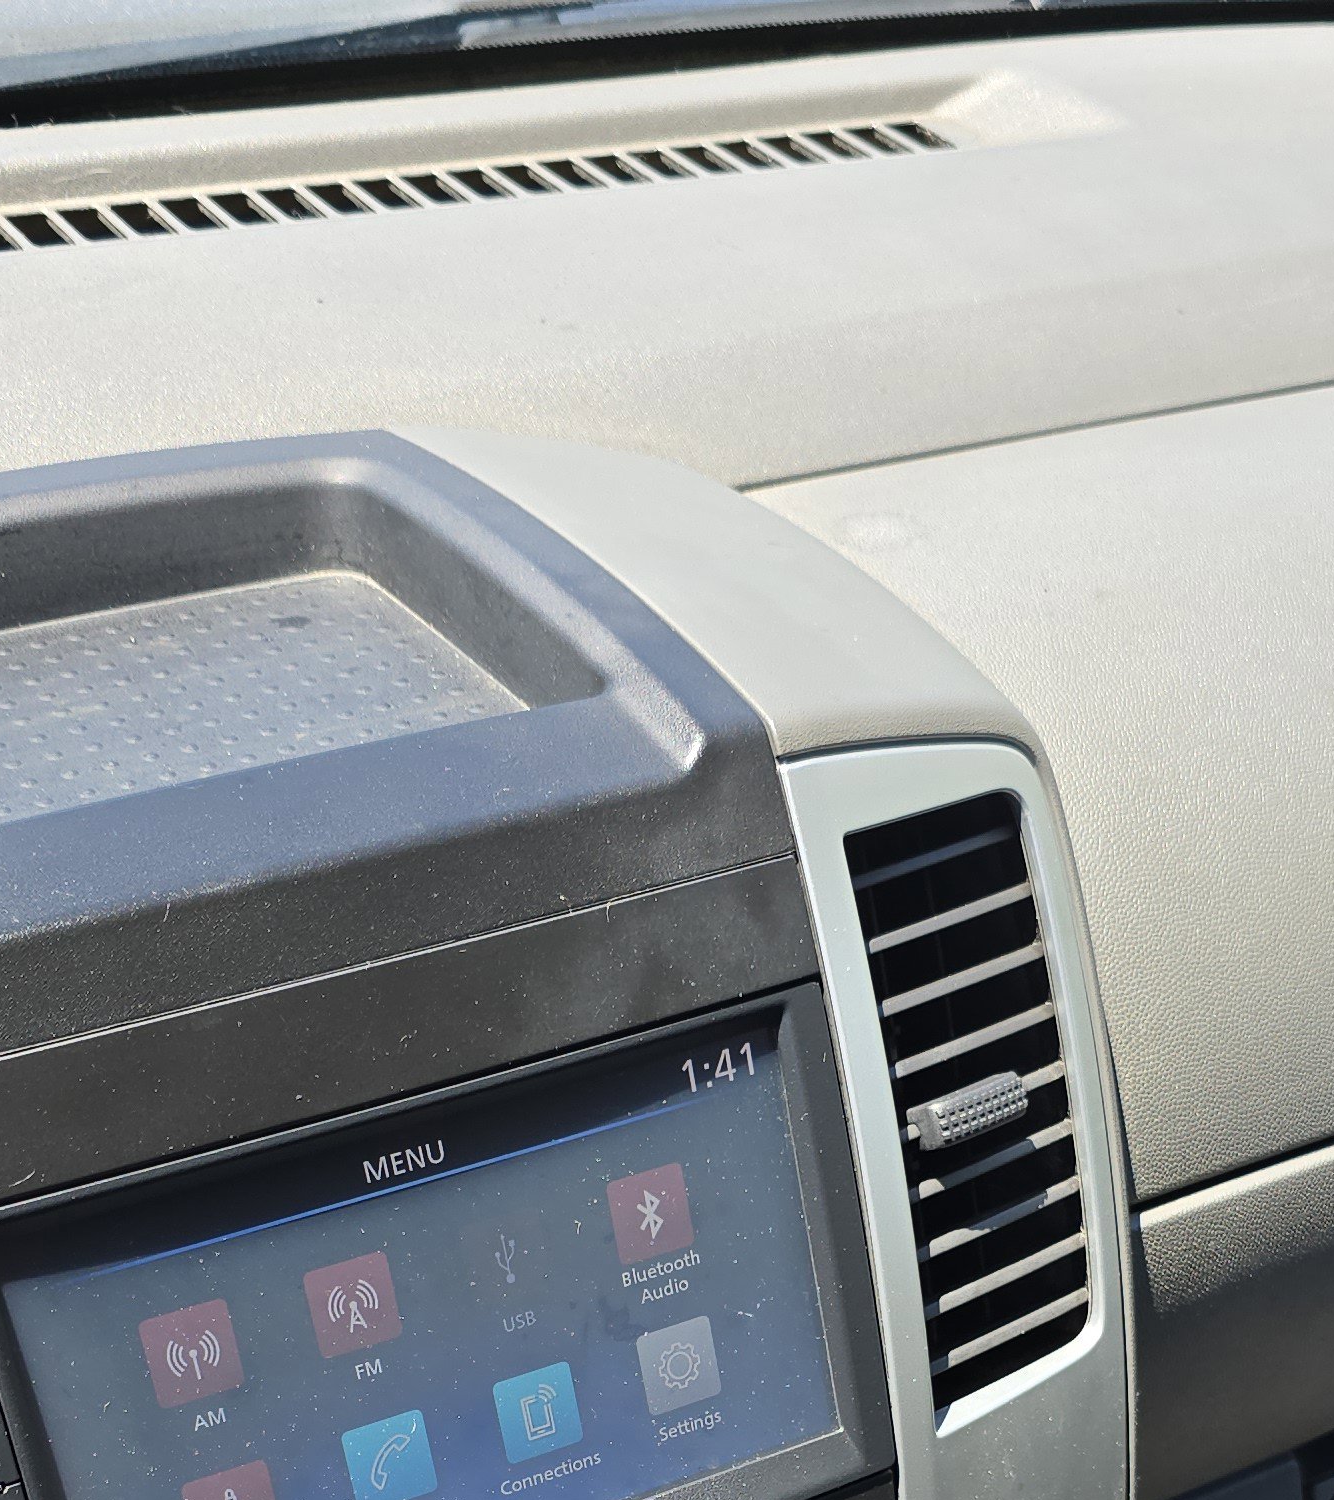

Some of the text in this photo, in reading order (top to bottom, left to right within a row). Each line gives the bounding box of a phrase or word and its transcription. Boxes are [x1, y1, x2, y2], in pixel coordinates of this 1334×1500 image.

[681, 1042, 755, 1093] 1:41
[361, 1139, 446, 1185] MENU
[620, 1249, 701, 1288] Bluetooth
[640, 1275, 690, 1305] Audio
[502, 1310, 537, 1334] USB
[354, 1358, 383, 1380] FM
[193, 1407, 227, 1432] AM
[658, 1409, 723, 1443] Settings
[500, 1453, 602, 1496] Connections
